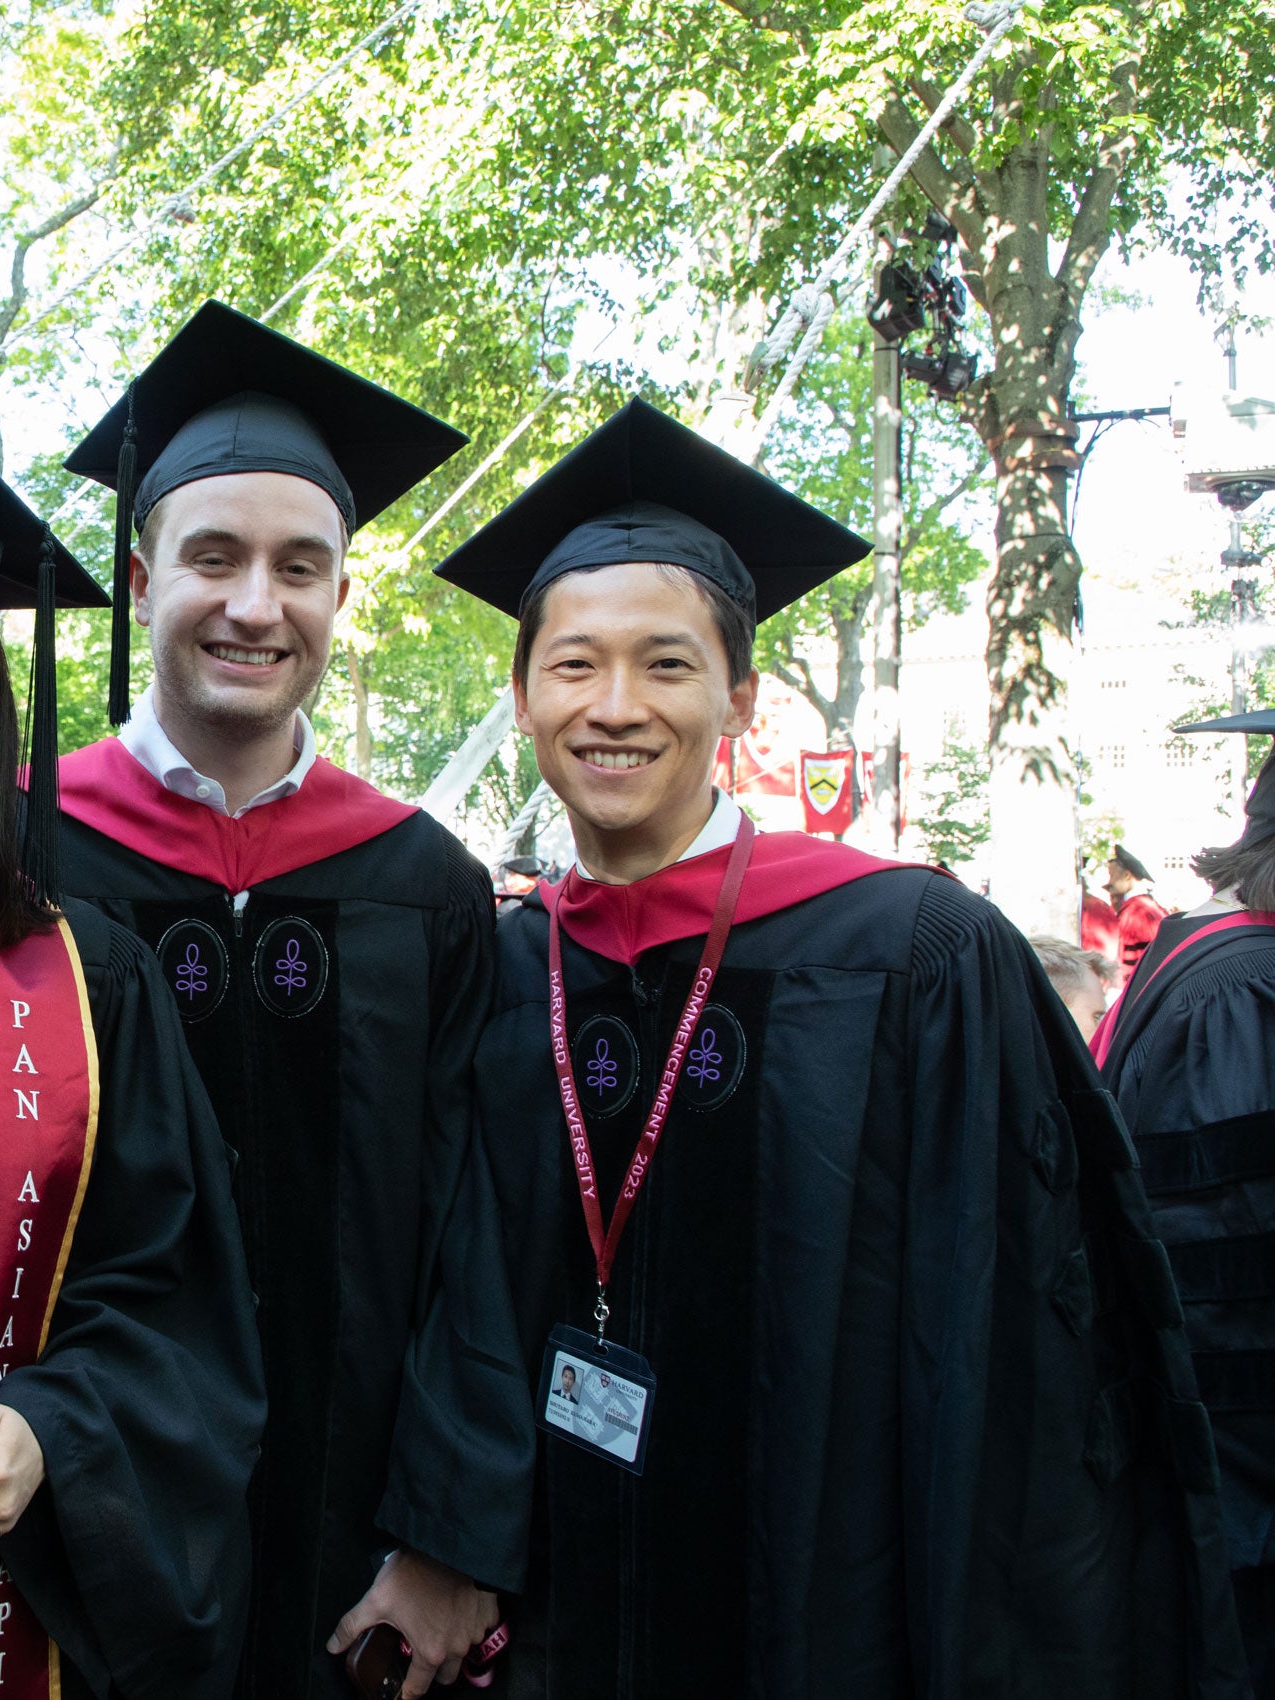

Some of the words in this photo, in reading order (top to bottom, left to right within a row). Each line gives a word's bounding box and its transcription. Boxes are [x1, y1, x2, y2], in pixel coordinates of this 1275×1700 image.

[10, 1000, 40, 1121] PAN
[550, 970, 567, 1064] HARVARD
[560, 1076, 596, 1199] UNIVERSITY
[645, 967, 712, 1143] COMMENCEMENT
[624, 1152, 648, 1198] 2023
[611, 1381, 644, 1399] HARVARD
